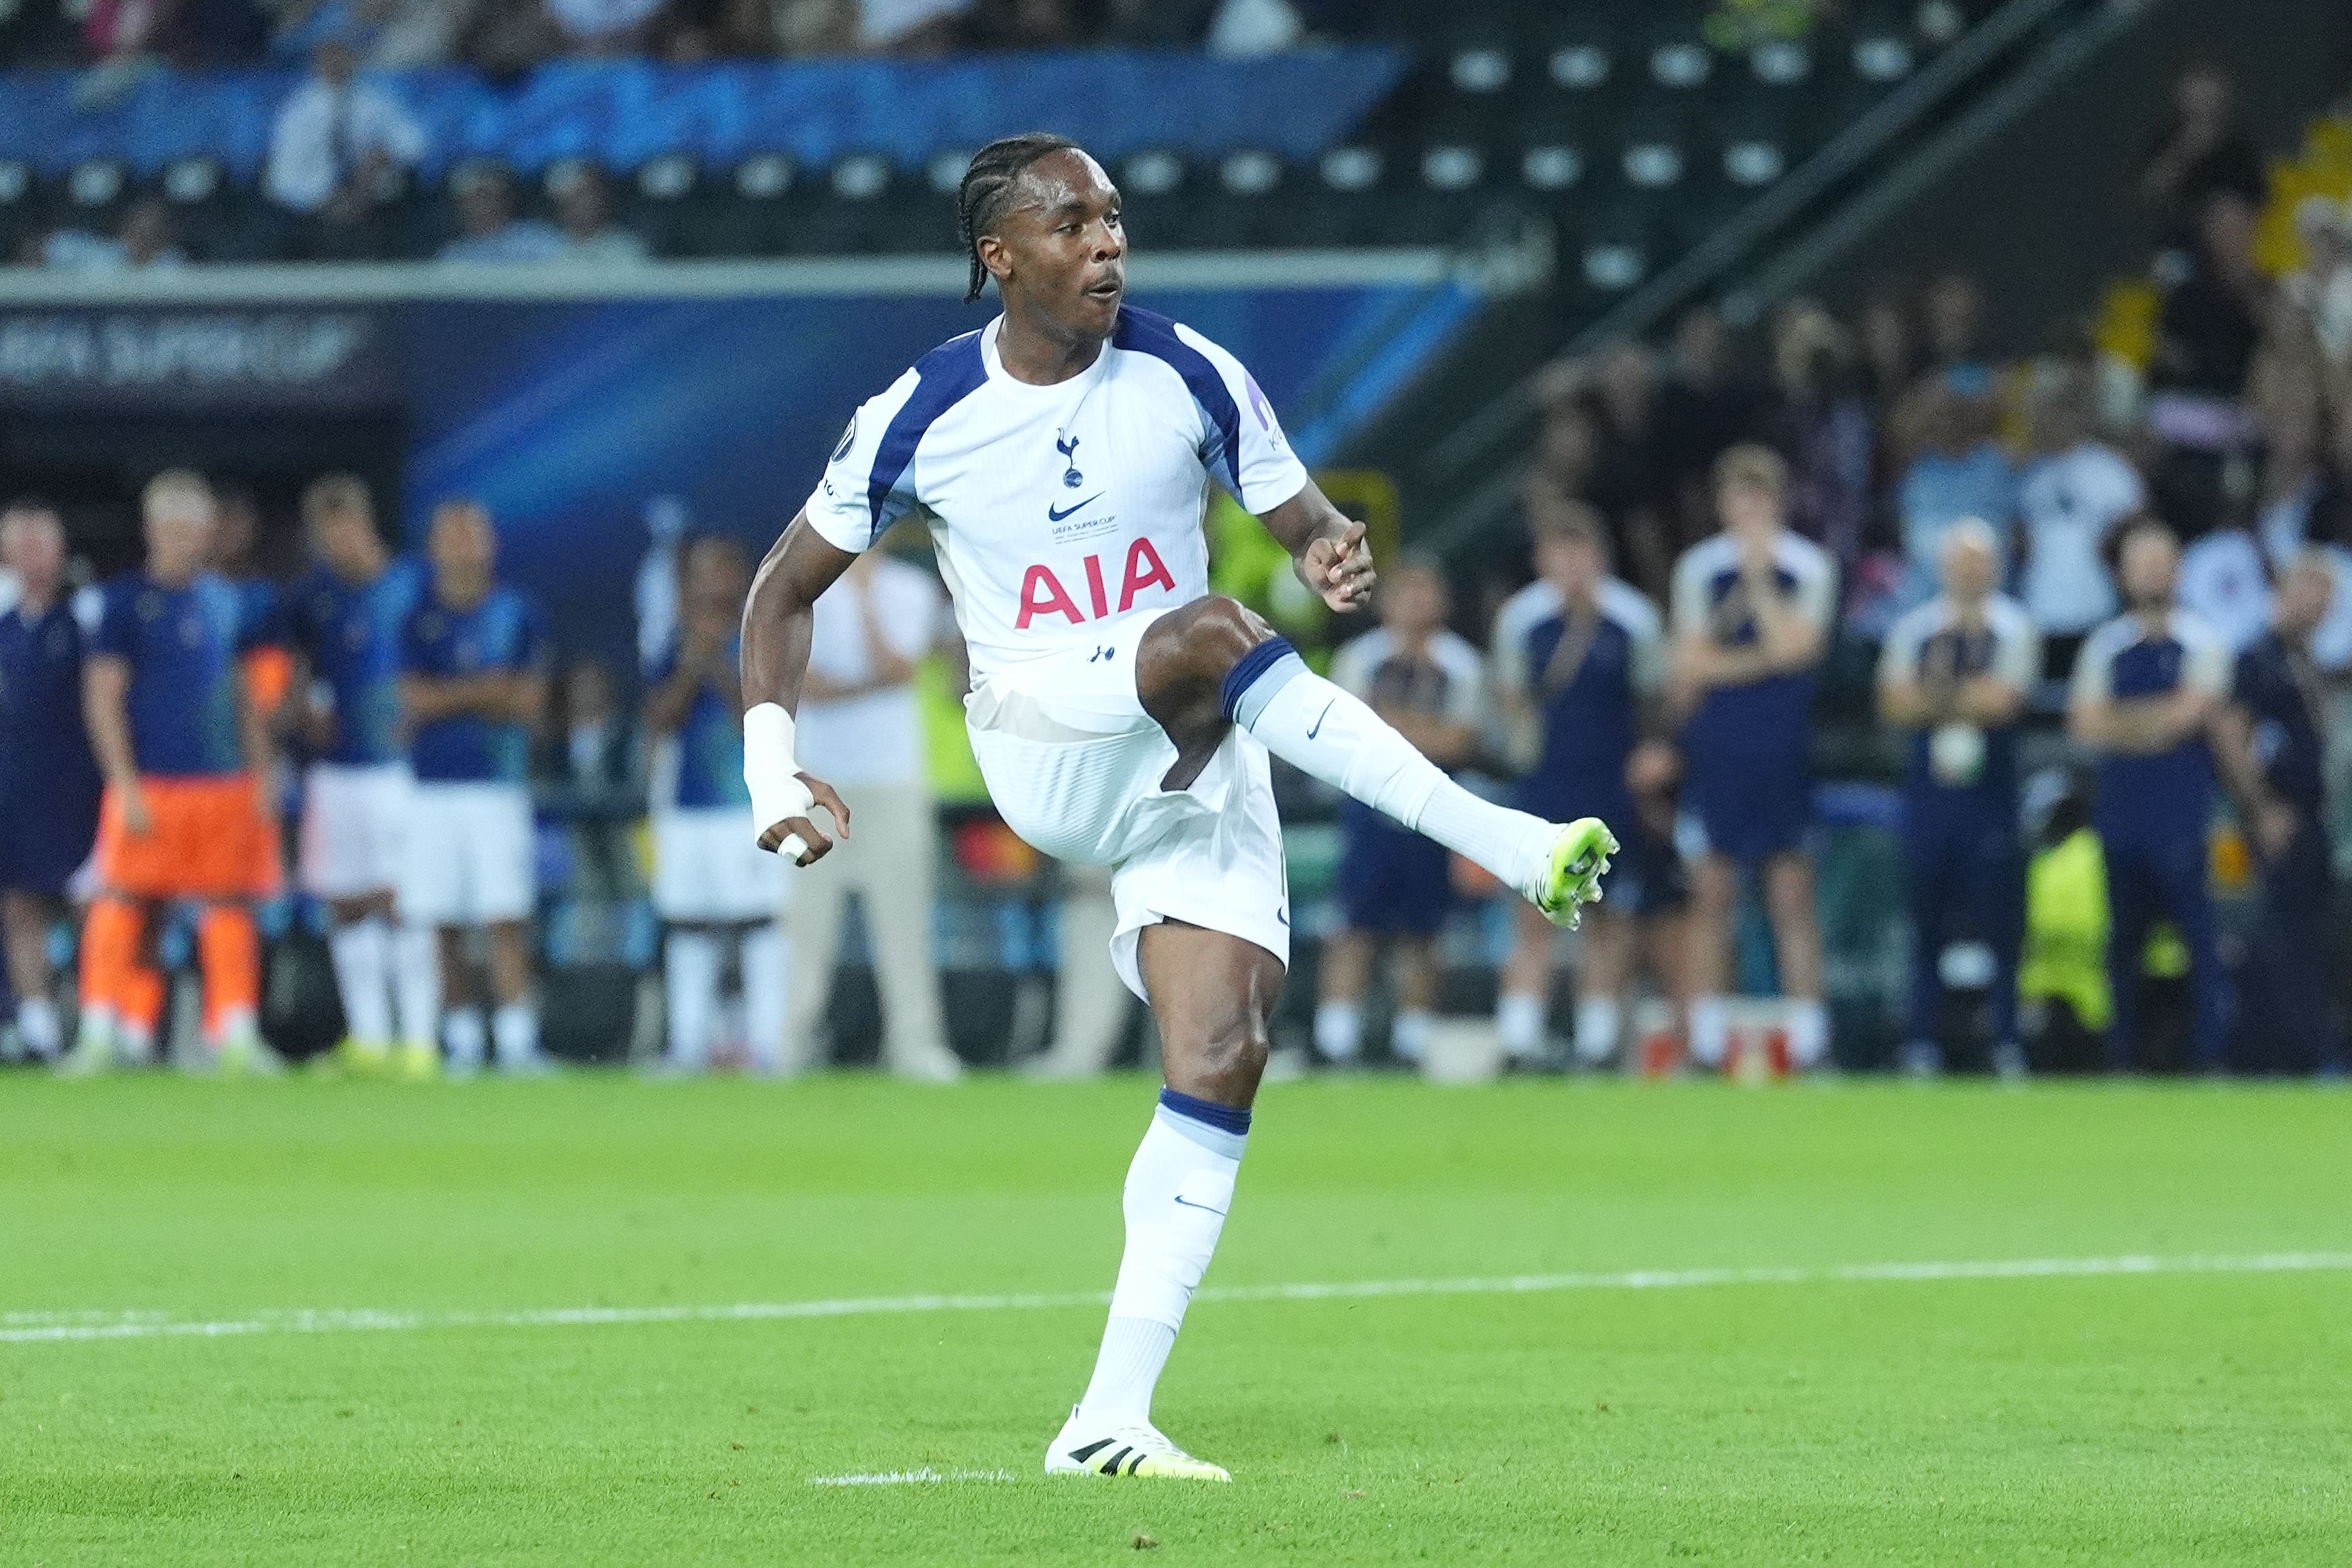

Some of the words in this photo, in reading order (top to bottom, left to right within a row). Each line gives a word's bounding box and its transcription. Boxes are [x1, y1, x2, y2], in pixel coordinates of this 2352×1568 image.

[1053, 525, 1073, 535] UEFA
[1074, 519, 1098, 531] SUPER
[1099, 516, 1116, 524] CUP
[1014, 537, 1176, 629] AIA
